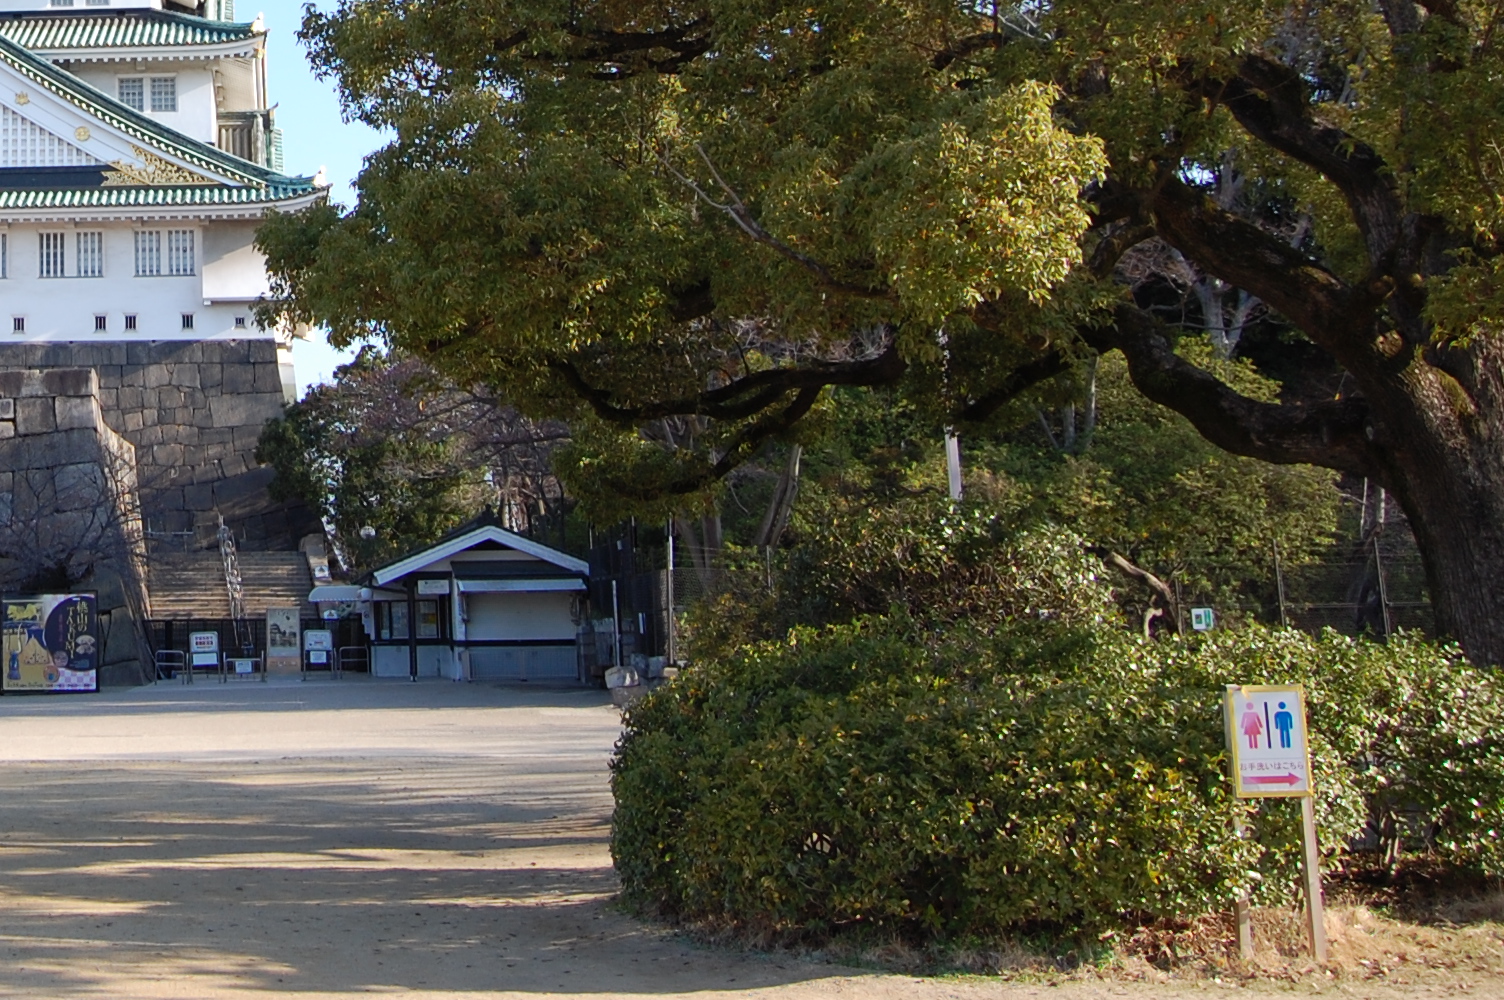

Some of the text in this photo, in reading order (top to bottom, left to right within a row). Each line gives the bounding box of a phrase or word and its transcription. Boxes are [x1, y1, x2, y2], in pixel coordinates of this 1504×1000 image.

[1240, 761, 1304, 771] お手洗いはこちら
